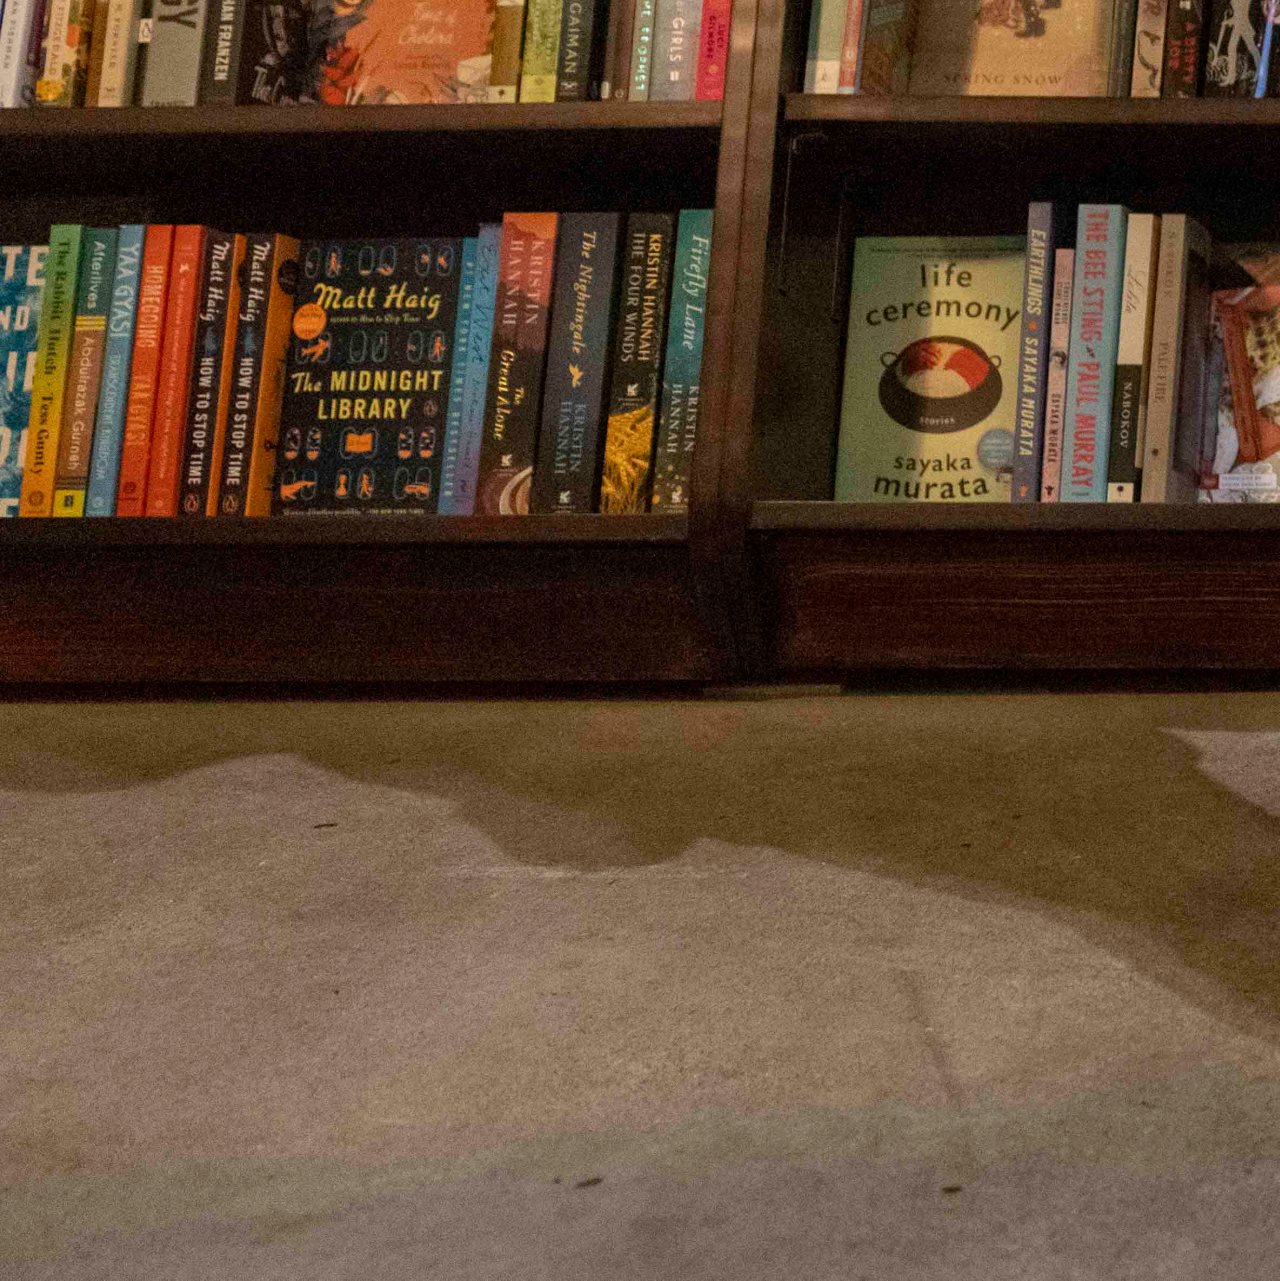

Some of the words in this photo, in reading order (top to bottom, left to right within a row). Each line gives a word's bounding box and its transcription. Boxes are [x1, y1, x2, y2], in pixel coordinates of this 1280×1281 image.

[214, 23, 233, 81] FRANZEN
[563, 2, 581, 74] GAIMAN
[579, 230, 597, 259] The
[630, 232, 646, 260] THE
[1085, 211, 1109, 242] THE
[58, 240, 72, 268] The
[86, 240, 107, 309] Afterlives
[210, 241, 231, 284] Matt
[250, 241, 271, 284] Matt
[645, 233, 662, 291] KRISTIN
[681, 233, 709, 302] Firefly
[918, 263, 974, 290] life
[1026, 228, 1047, 316] EARTHLINGS
[1083, 249, 1106, 280] BEE
[51, 270, 70, 321] Rabbit
[200, 285, 226, 323] Haig
[239, 284, 267, 323] Haig
[313, 281, 377, 311] Matt
[382, 280, 442, 318] Haig
[502, 239, 525, 325] HANNAH
[525, 239, 546, 325] KRISTIN
[626, 265, 643, 307] FOUR
[137, 265, 164, 348] HOMEGOING
[570, 263, 593, 355] Nightingale
[637, 294, 654, 362] HANNAH
[682, 303, 703, 351] Lane
[864, 299, 1021, 332] ceremony
[1079, 286, 1104, 342] STING
[45, 328, 63, 376] Hutch
[620, 311, 638, 363] WINDS
[74, 336, 95, 417] Abdulrazak
[200, 357, 215, 385] HOW
[239, 357, 254, 385] HOW
[291, 371, 323, 393] The
[330, 369, 443, 392] MIDNIGHT
[496, 349, 515, 392] Great
[1021, 336, 1038, 394] SAYAKA
[1076, 361, 1101, 407] PAUL
[40, 394, 55, 425] Tess
[196, 389, 210, 411] TO
[235, 389, 250, 411] TO
[317, 397, 413, 420] LIBRARY
[492, 394, 509, 441] Alone
[666, 383, 683, 454] HANNAH
[684, 384, 700, 453] KRISTIN
[1119, 381, 1133, 449] NABOKOV
[67, 420, 86, 471] Gurnah
[191, 414, 207, 449] STOP
[228, 414, 248, 449] STOP
[554, 400, 573, 475] HANNAH
[570, 403, 588, 474] KRISTIN
[1018, 397, 1035, 457] MURATA
[1071, 412, 1098, 488] MURRAY
[32, 428, 51, 477] Gunty
[186, 450, 203, 487] TIME
[224, 450, 242, 487] TIME
[893, 453, 973, 476] sayaka
[872, 473, 990, 500] murata
